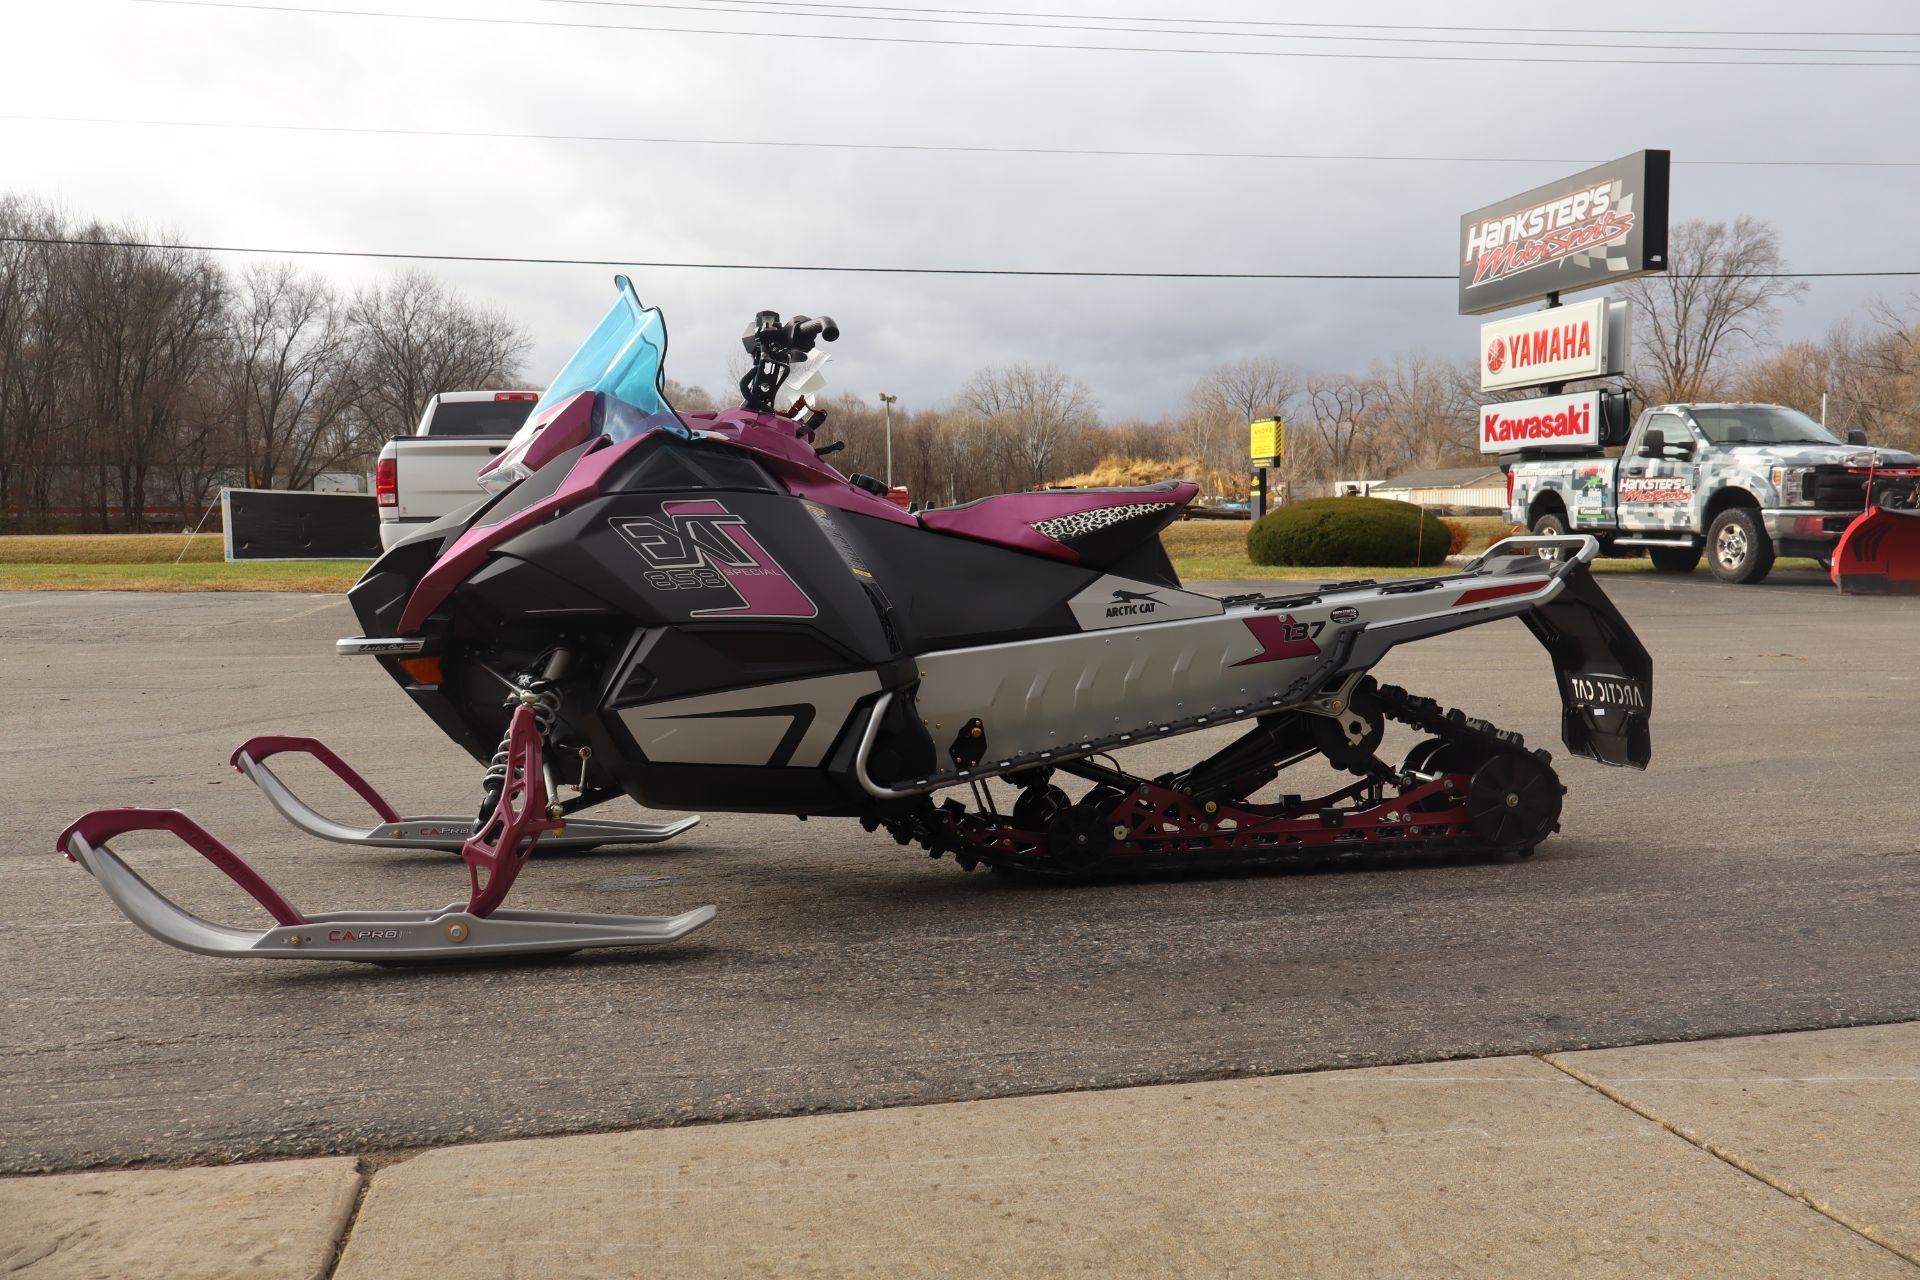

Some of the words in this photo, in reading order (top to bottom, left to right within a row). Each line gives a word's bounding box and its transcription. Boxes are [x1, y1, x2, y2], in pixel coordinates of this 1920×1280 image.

[1509, 320, 1591, 369] YAMAHA
[1485, 402, 1590, 442] Kawasaki
[643, 568, 727, 590] 858
[723, 568, 782, 576] SPECIAL
[1105, 604, 1138, 618] ARCTIC
[1139, 602, 1156, 615] CAT
[1282, 621, 1326, 642] 137
